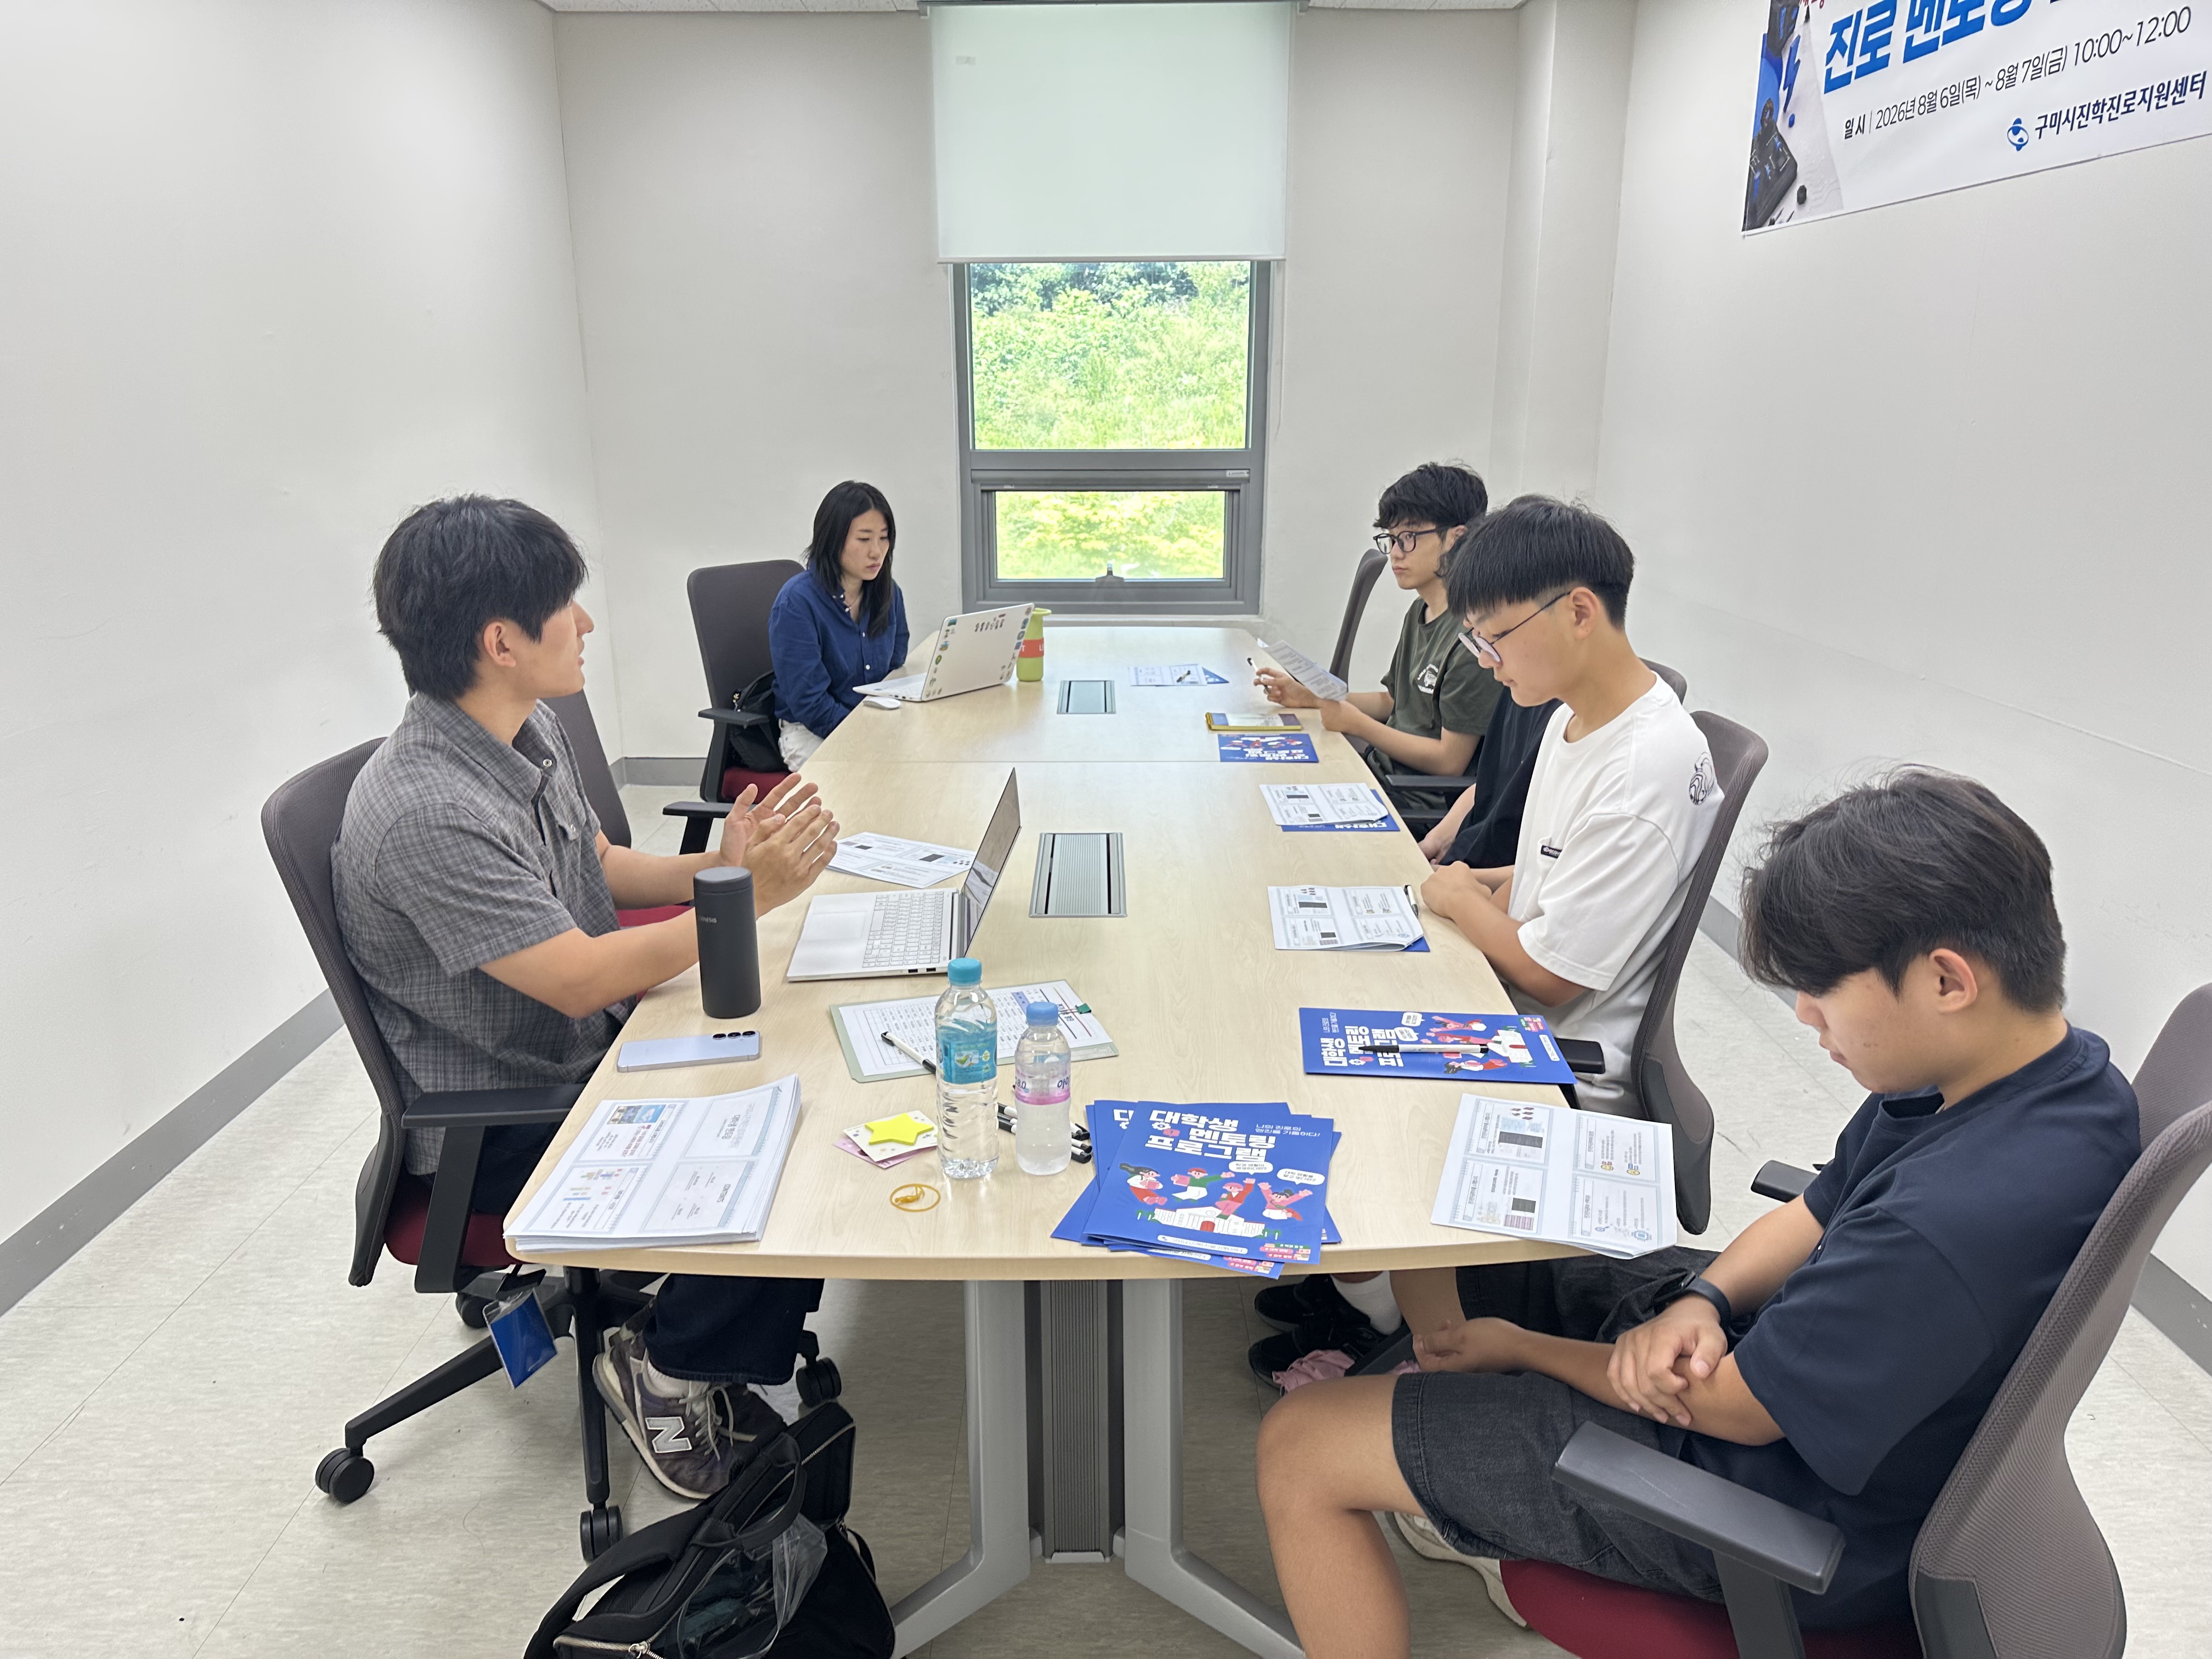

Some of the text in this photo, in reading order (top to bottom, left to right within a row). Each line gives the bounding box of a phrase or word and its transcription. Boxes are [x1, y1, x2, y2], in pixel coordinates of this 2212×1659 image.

[1824, 0, 1897, 94] 진로
[1844, 114, 1866, 140] 일시
[1876, 97, 1916, 129] 2026년
[1917, 89, 1938, 116] 8월
[1940, 75, 1981, 109] 6일(목)
[1995, 63, 2019, 91] 8월
[2022, 46, 2068, 83] 7일(금)
[2074, 6, 2192, 66] 10:00~12:00
[2034, 70, 2208, 139] 구미시진학진로지원센터
[1320, 1037, 1348, 1066] 대학생
[1149, 1109, 1239, 1132] 대학생
[1144, 1135, 1267, 1162] 프로그램
[1189, 1127, 1276, 1149] 멘토링
